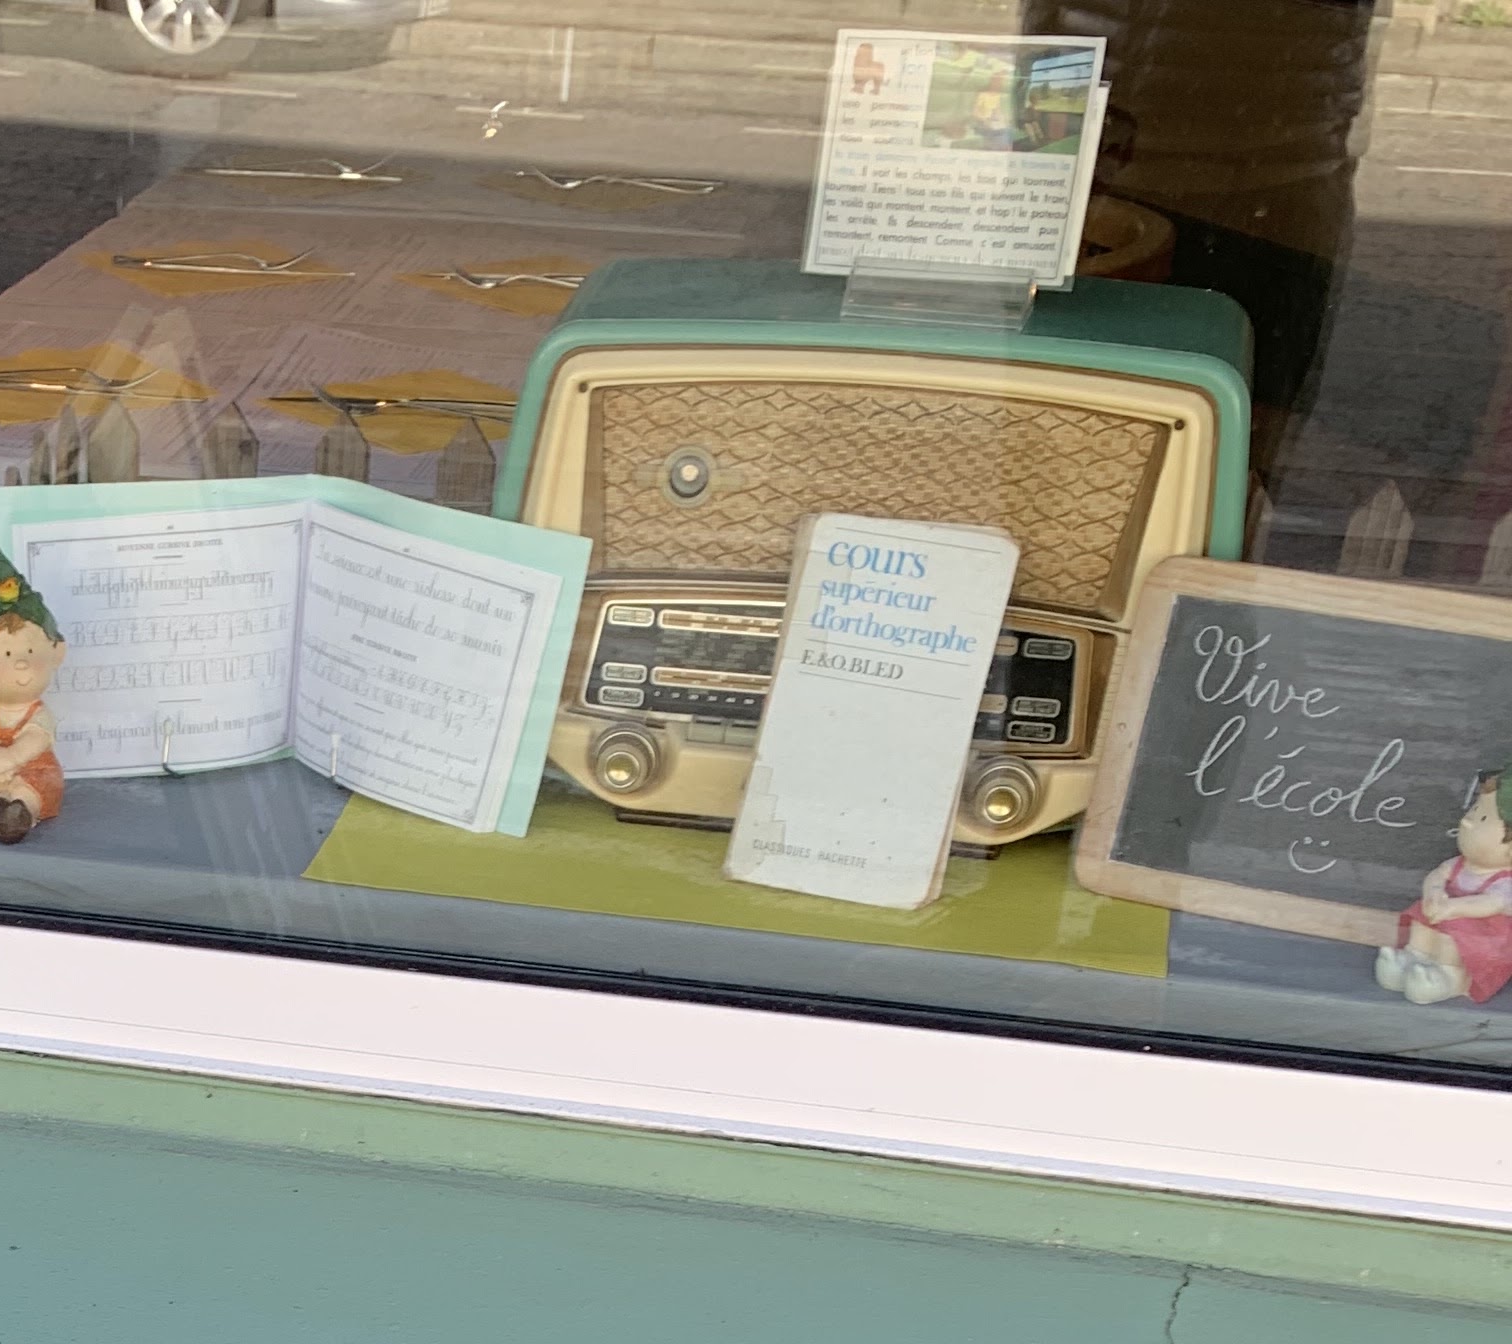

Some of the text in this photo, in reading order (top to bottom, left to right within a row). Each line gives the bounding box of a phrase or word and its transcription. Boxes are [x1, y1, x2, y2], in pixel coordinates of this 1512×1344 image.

[810, 604, 977, 654] d'orthographe
[820, 579, 937, 612] supérieur
[1193, 625, 1340, 718] Vive
[1185, 715, 1416, 828] l'école
